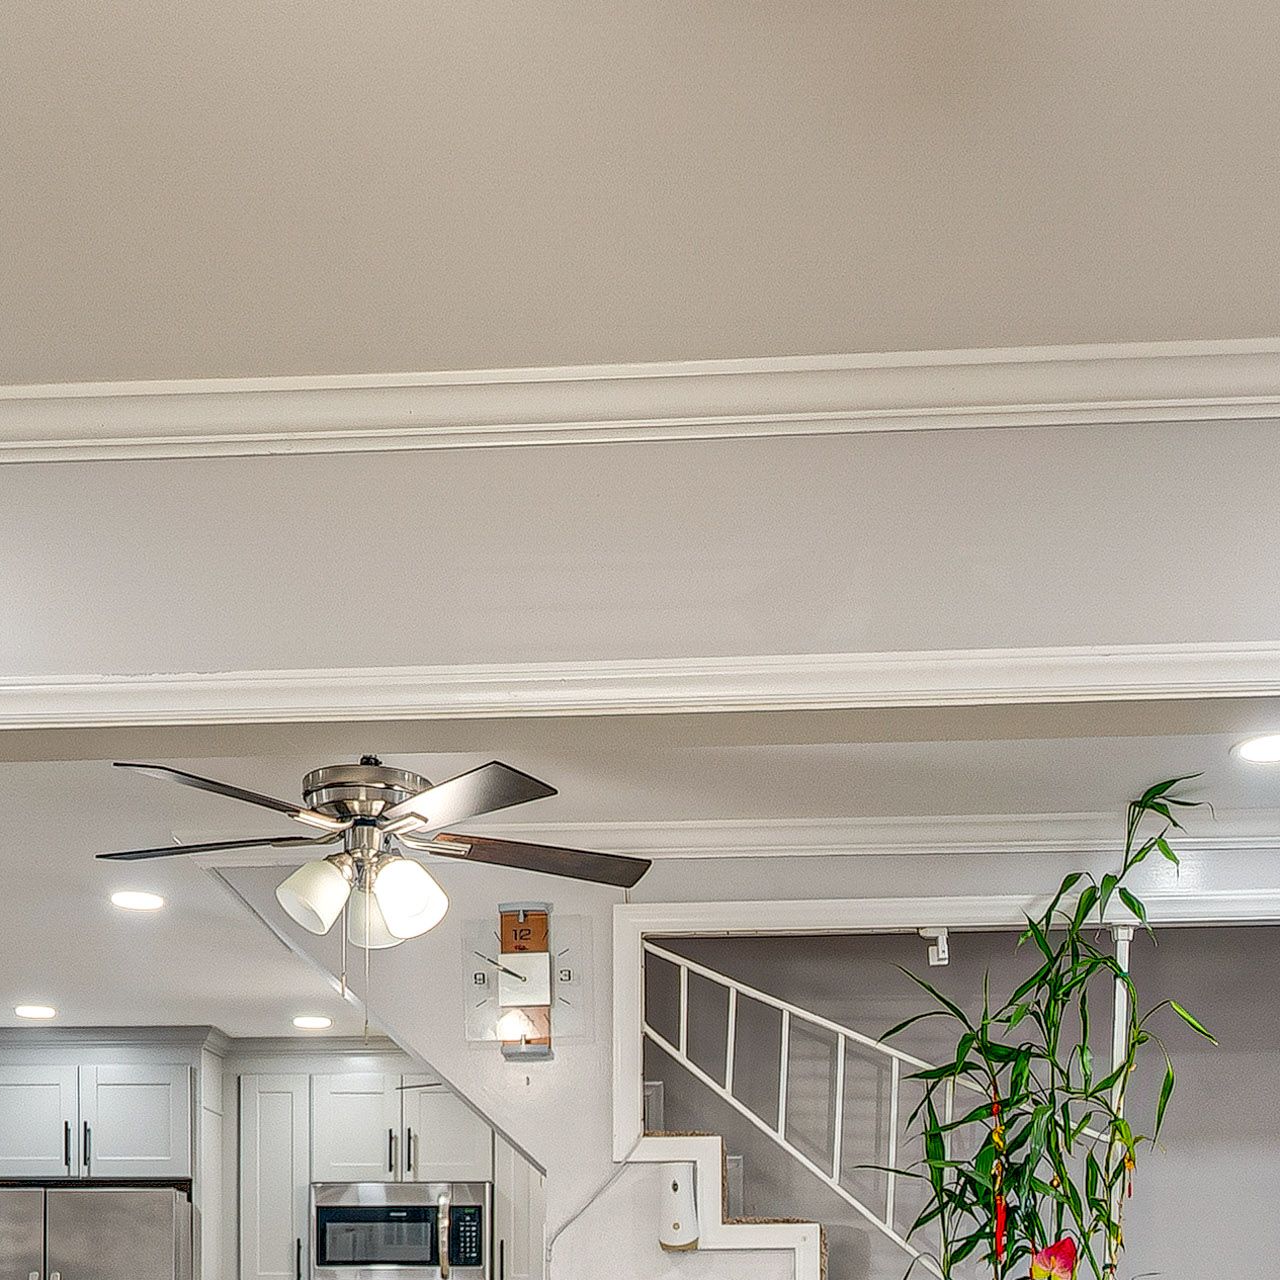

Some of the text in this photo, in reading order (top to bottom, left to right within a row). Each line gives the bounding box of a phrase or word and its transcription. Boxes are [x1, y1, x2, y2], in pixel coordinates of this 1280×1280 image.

[513, 928, 531, 940] 12
[474, 973, 485, 984] 9
[560, 970, 571, 981] 3
